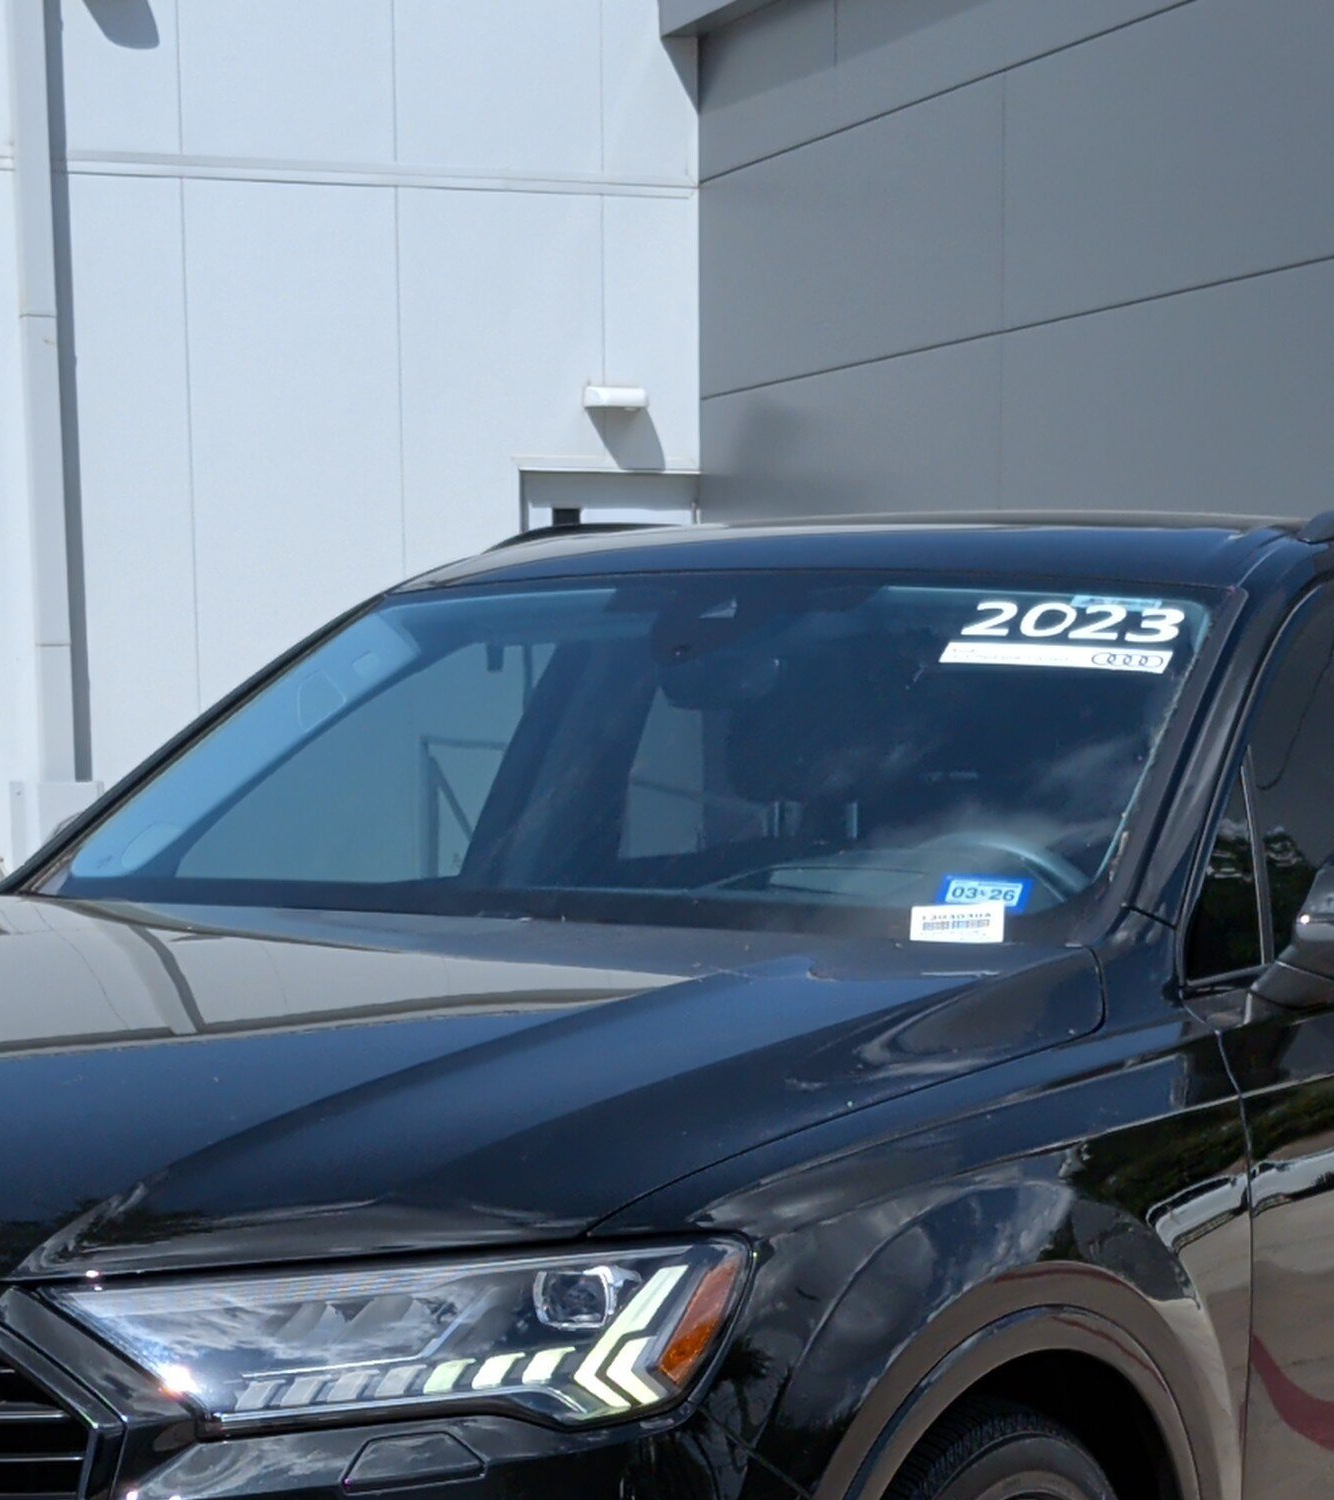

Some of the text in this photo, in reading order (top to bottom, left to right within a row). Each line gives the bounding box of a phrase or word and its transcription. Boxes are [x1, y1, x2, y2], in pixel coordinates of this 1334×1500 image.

[961, 601, 1185, 643] 2023
[951, 886, 1016, 902] 03 26
